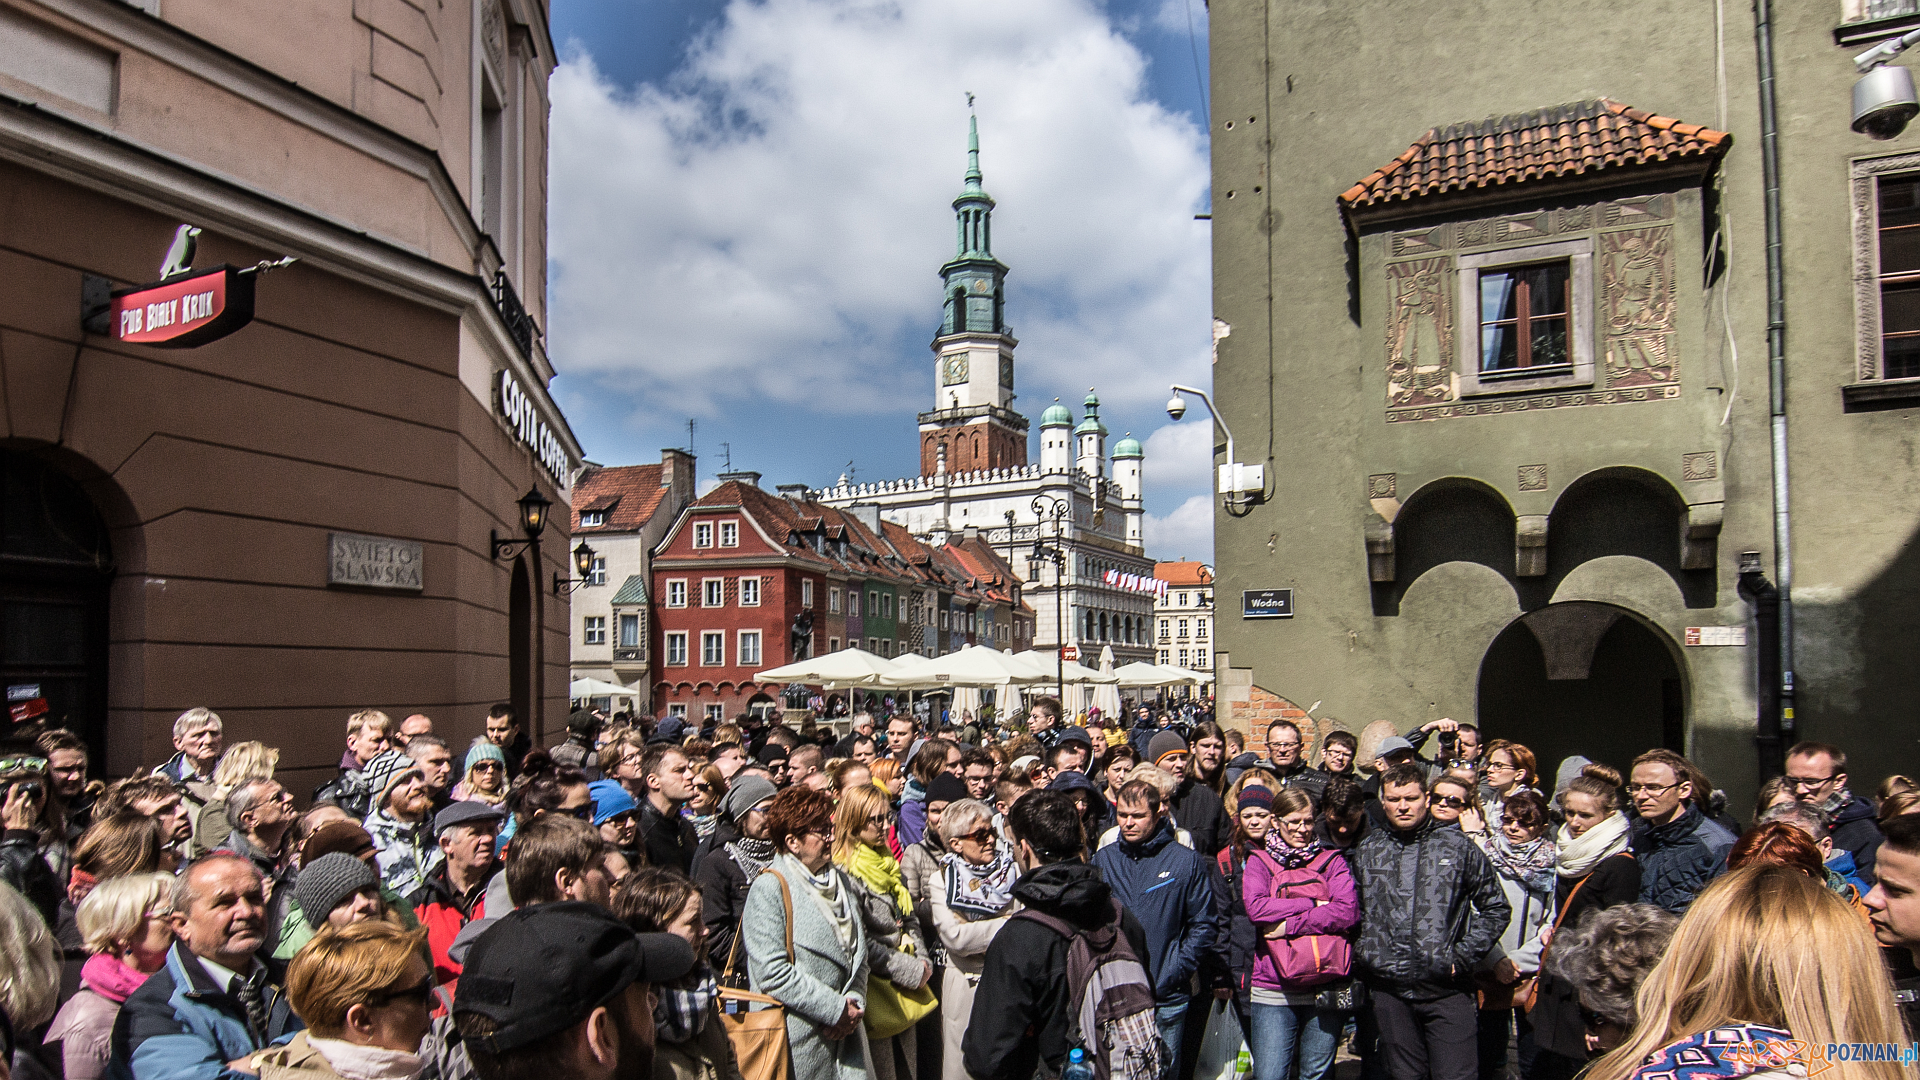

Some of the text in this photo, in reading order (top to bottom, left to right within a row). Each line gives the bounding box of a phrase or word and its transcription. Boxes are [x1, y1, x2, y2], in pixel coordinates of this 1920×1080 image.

[120, 308, 143, 338] PUB
[181, 291, 214, 324] KRUK
[502, 368, 569, 490] COSTA COFFEE
[1251, 598, 1285, 608] Wodna
